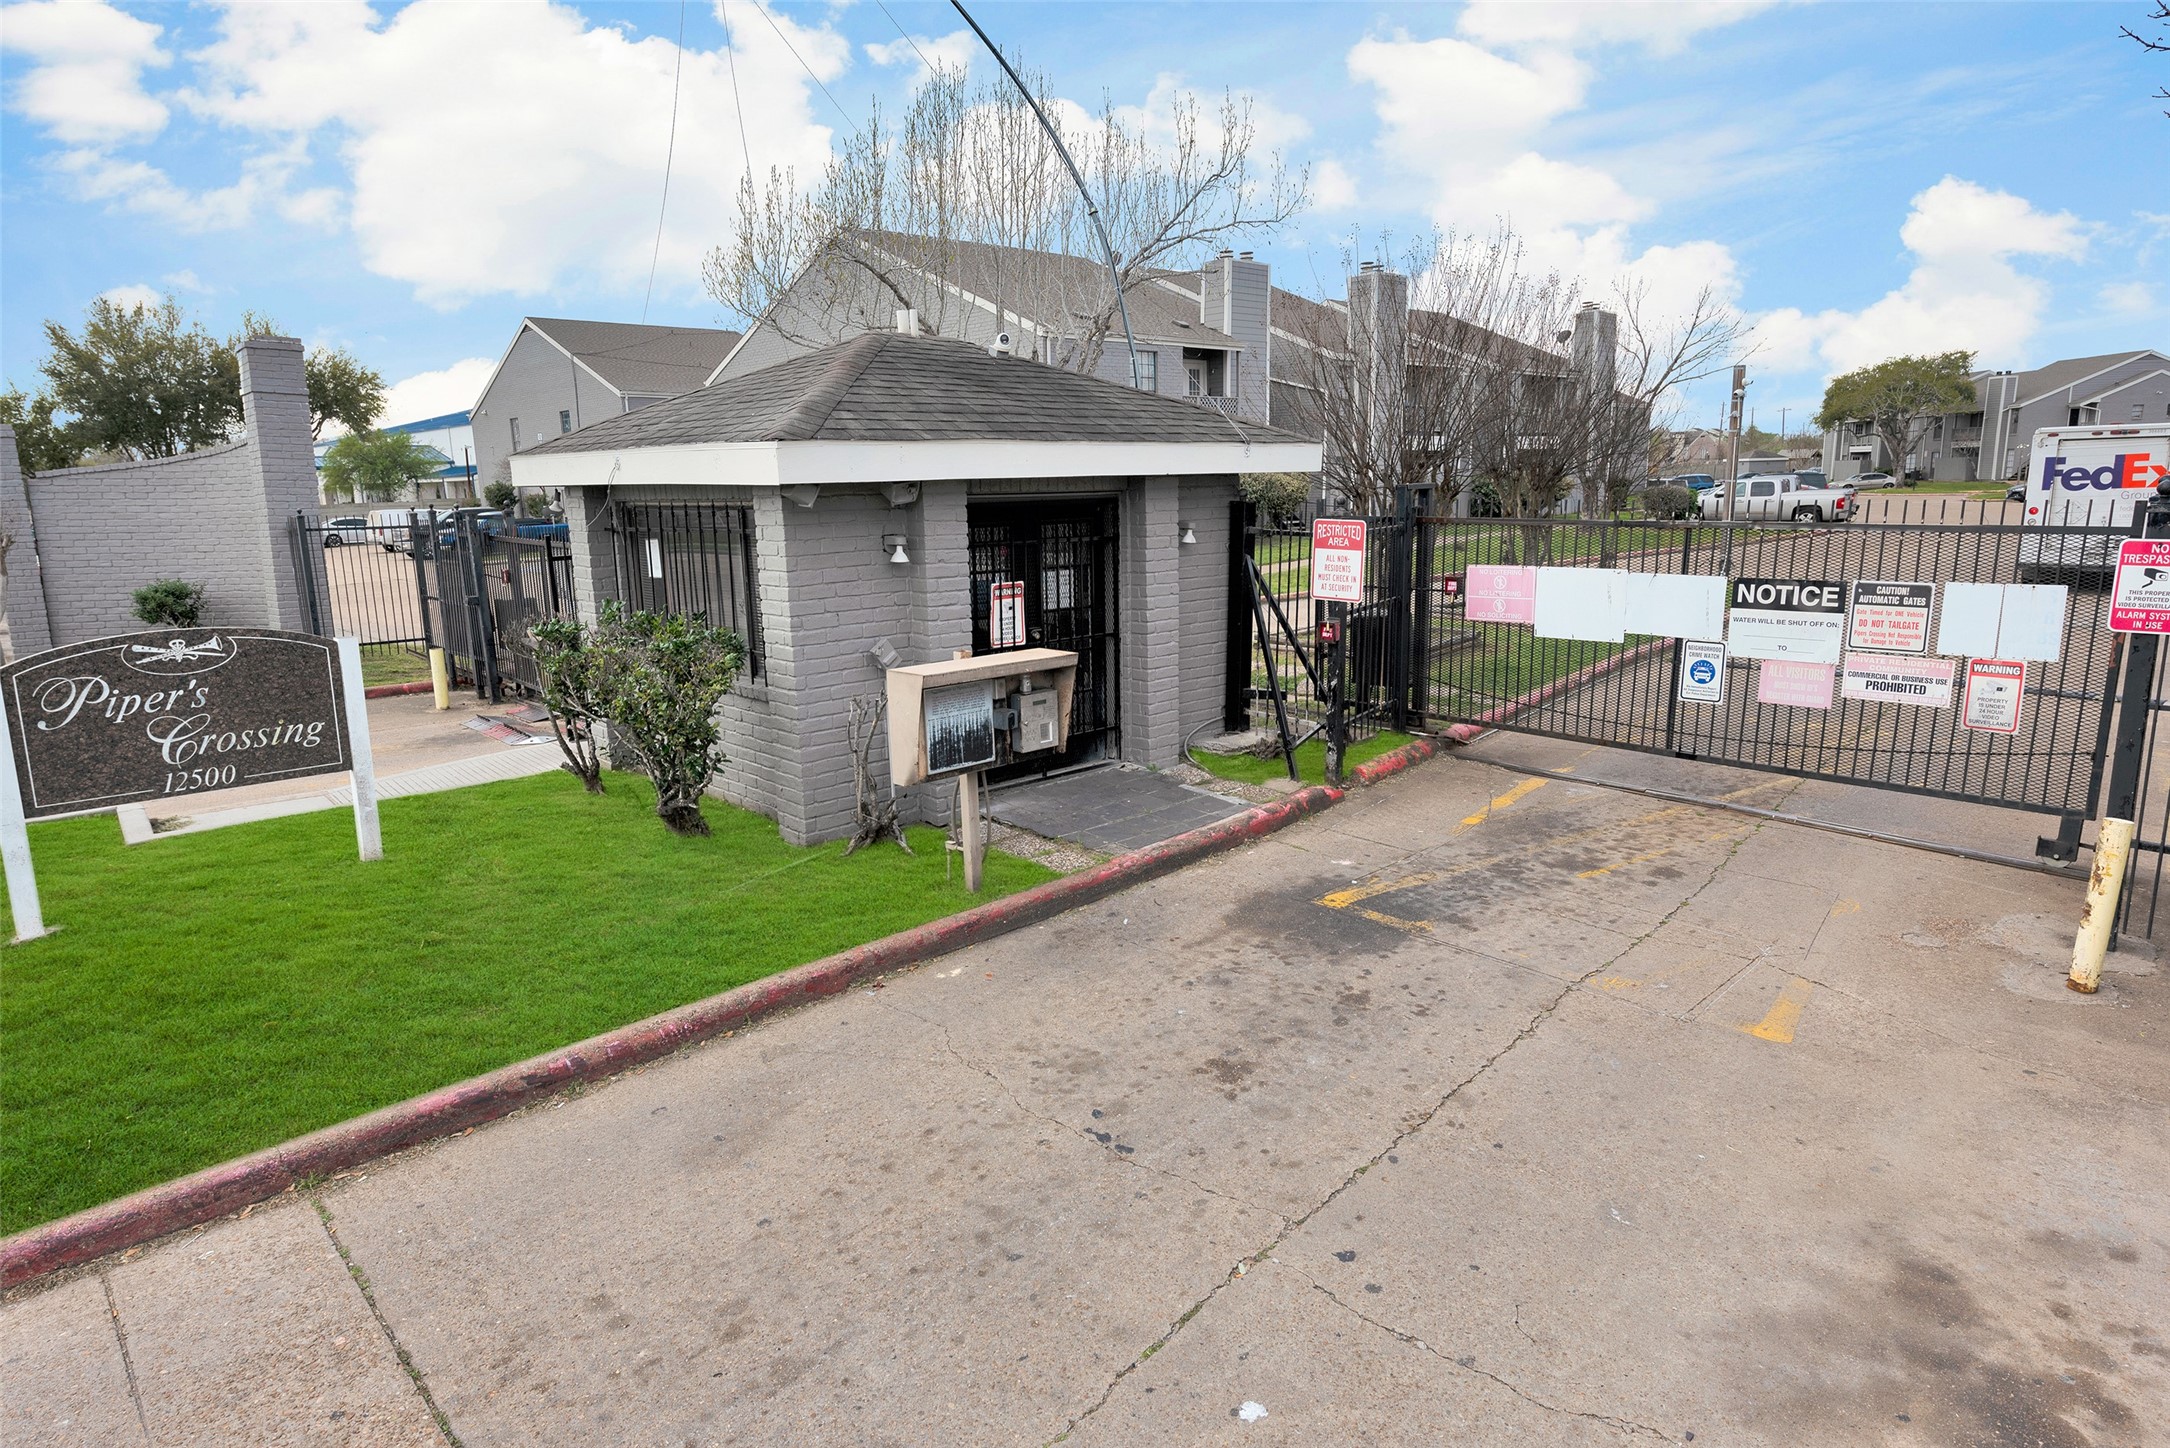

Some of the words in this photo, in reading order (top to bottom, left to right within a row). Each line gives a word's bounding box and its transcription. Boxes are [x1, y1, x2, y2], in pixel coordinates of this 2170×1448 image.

[1317, 524, 1362, 541] RESTRICTED
[1327, 537, 1350, 547] AREA
[2151, 544, 2170, 555] NO
[1325, 554, 1336, 563] ALL
[1336, 555, 1351, 564] NON-
[1324, 563, 1352, 574] RESIDENTS
[1317, 573, 1331, 582] MUST
[1332, 575, 1350, 584] CHECK
[1350, 576, 1357, 584] IN
[1320, 583, 1328, 591] AT
[1328, 584, 1353, 594] SECURITY
[1876, 586, 1910, 595] CAUTION!
[1737, 583, 1840, 608] NOTICE
[1859, 595, 1900, 604] AUTOMATIC
[1903, 597, 1927, 606] GATES
[1488, 612, 1522, 620] SOLICITING
[2116, 611, 2146, 620] ALARM
[1859, 619, 1868, 628] DO
[1871, 620, 1884, 628] NOT
[1888, 620, 1920, 630] TAILGATE
[2132, 621, 2143, 629] IN
[2145, 622, 2163, 630] USE
[1868, 631, 1886, 639] Crossing
[1898, 633, 1922, 641] Responsible
[1688, 644, 1722, 653] NEIGHBORHOOD
[1870, 639, 1886, 647] Damage
[1848, 655, 1886, 665] PRIVATE
[1889, 659, 1952, 670] RESIDENTIAL
[1768, 664, 1784, 678] ALL
[1786, 667, 1826, 682] VISITORS
[1869, 665, 1928, 676] COMMUNITY
[1973, 664, 2020, 675] WARNING
[1848, 671, 1889, 680] COMMERCIAL
[1902, 675, 1934, 684] BUSINESS
[1865, 680, 1927, 695] PROHIBITED
[32, 675, 209, 731] Piper's
[1969, 719, 2012, 728] SURVEILLANCE
[146, 713, 325, 769] Crossing
[163, 764, 236, 794] 12500
